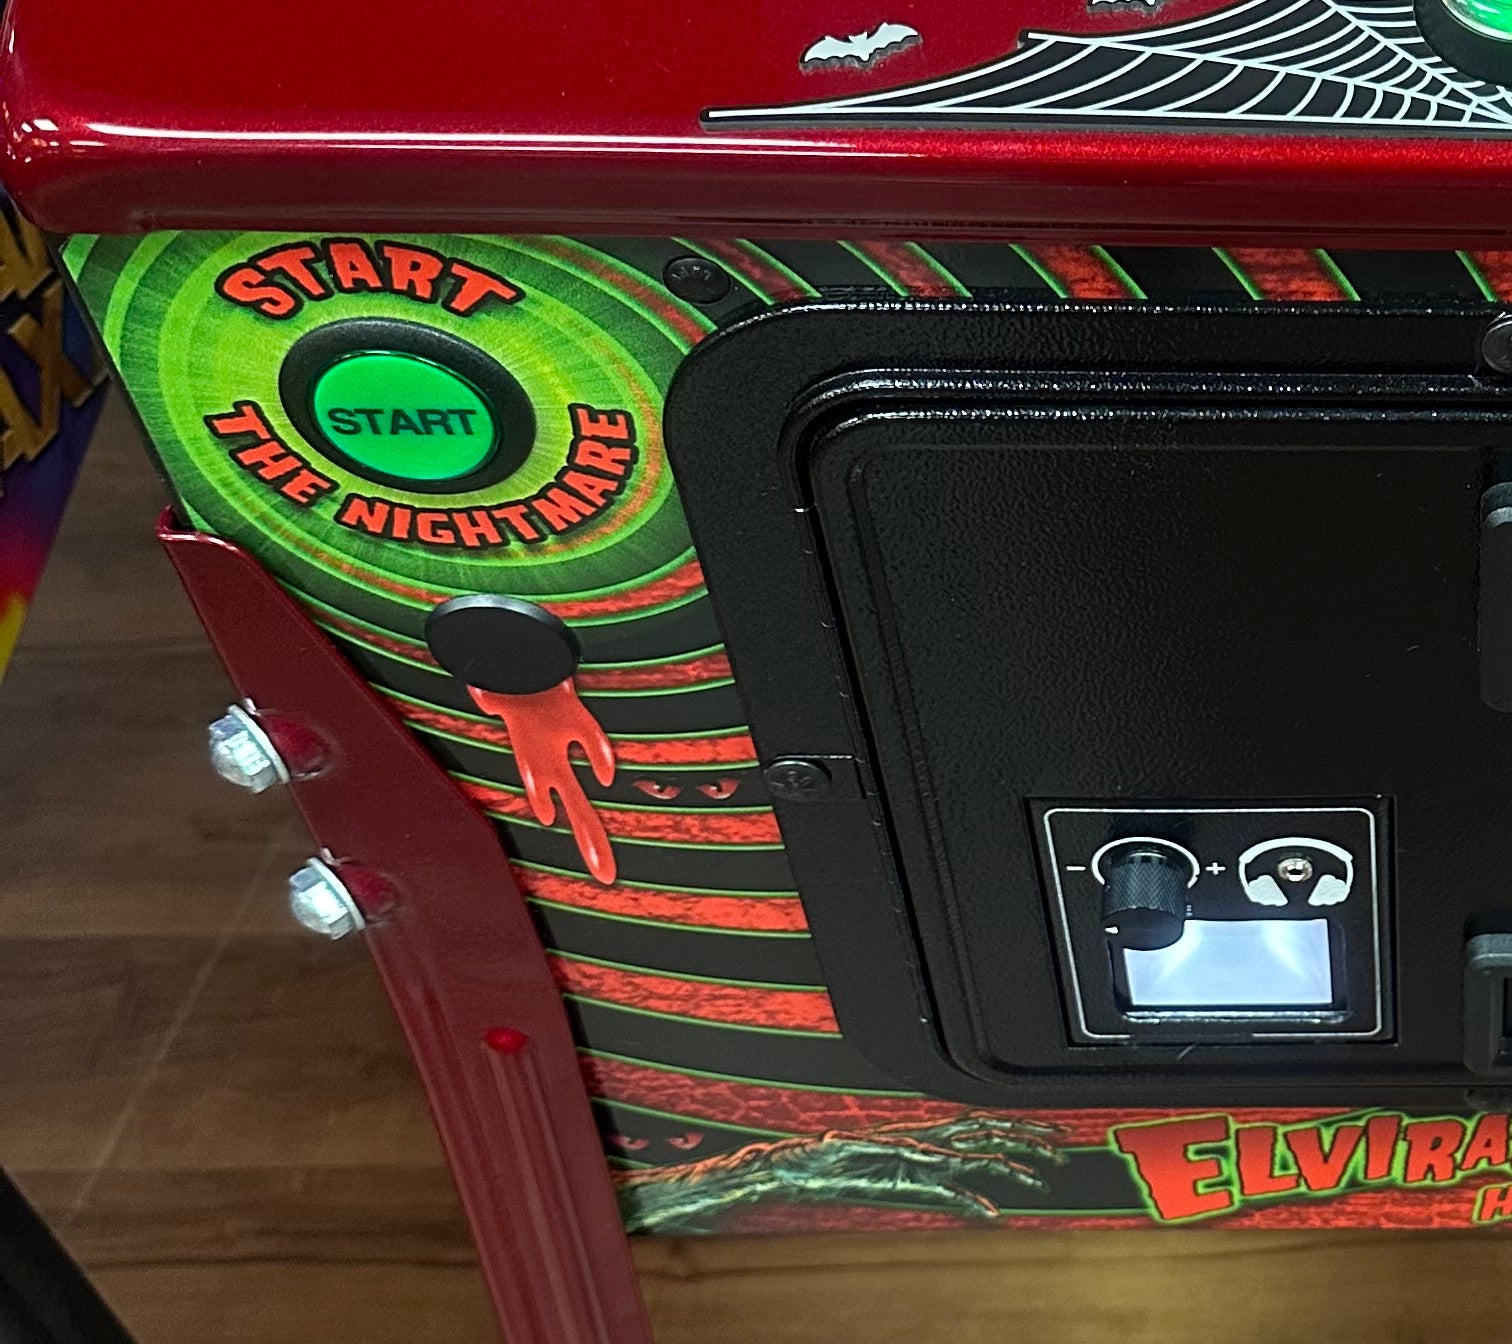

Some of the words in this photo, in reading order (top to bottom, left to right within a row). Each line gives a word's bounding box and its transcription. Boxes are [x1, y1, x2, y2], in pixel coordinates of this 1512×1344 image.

[218, 239, 524, 318] START
[327, 407, 478, 436] START
[207, 403, 336, 505] THE
[338, 405, 635, 548] NIGHTMARE
